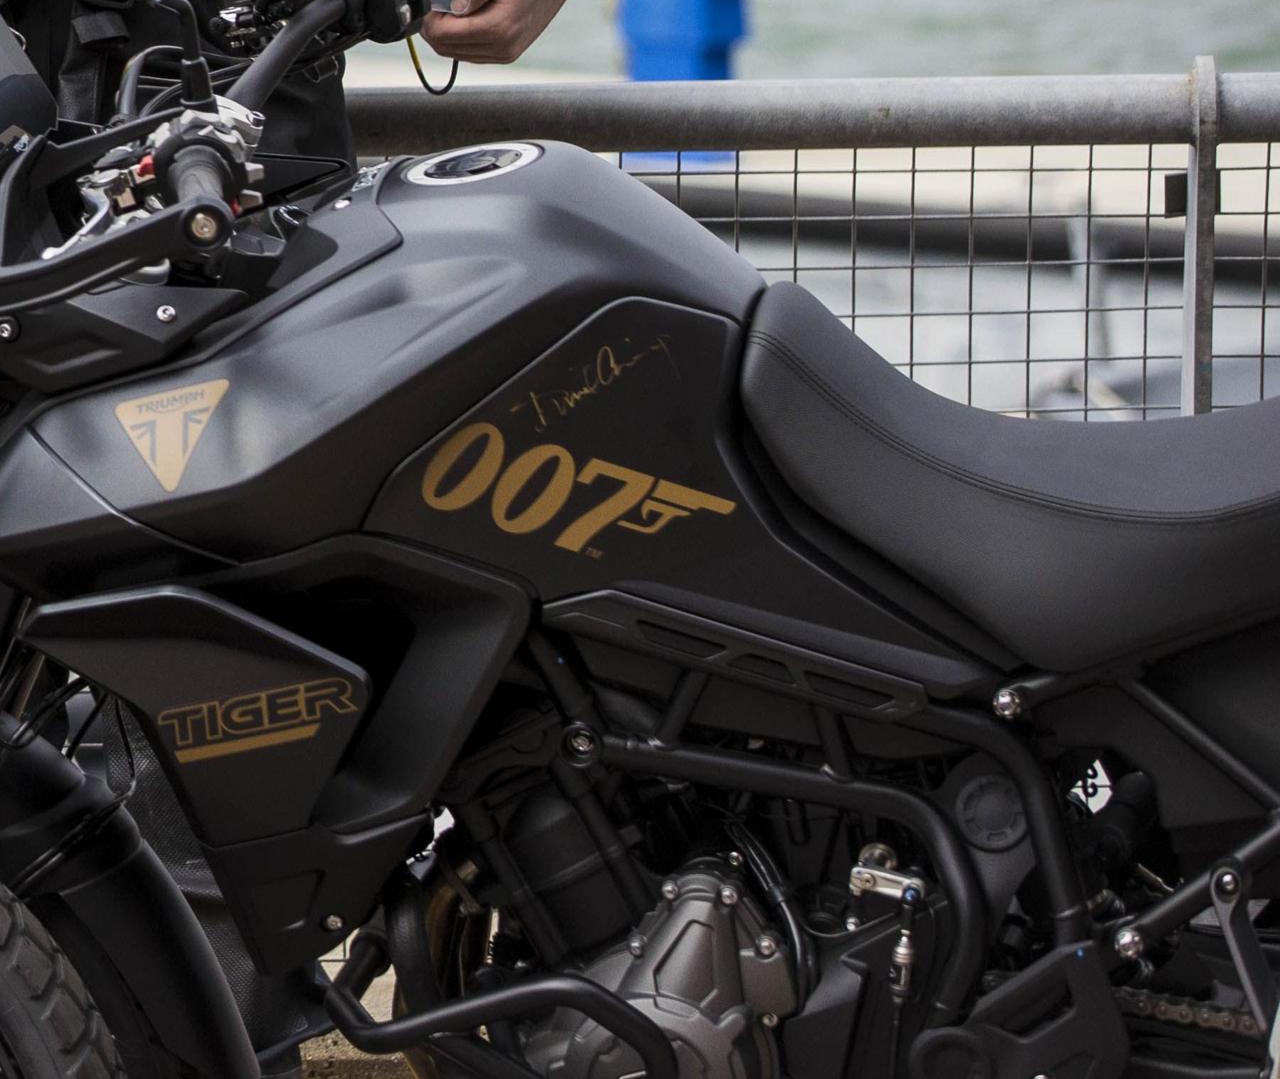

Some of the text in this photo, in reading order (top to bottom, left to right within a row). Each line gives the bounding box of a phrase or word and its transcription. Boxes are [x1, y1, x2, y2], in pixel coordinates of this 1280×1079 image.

[137, 390, 205, 415] TRIUMPH
[422, 422, 657, 553] 007
[158, 677, 359, 745] TIGER
